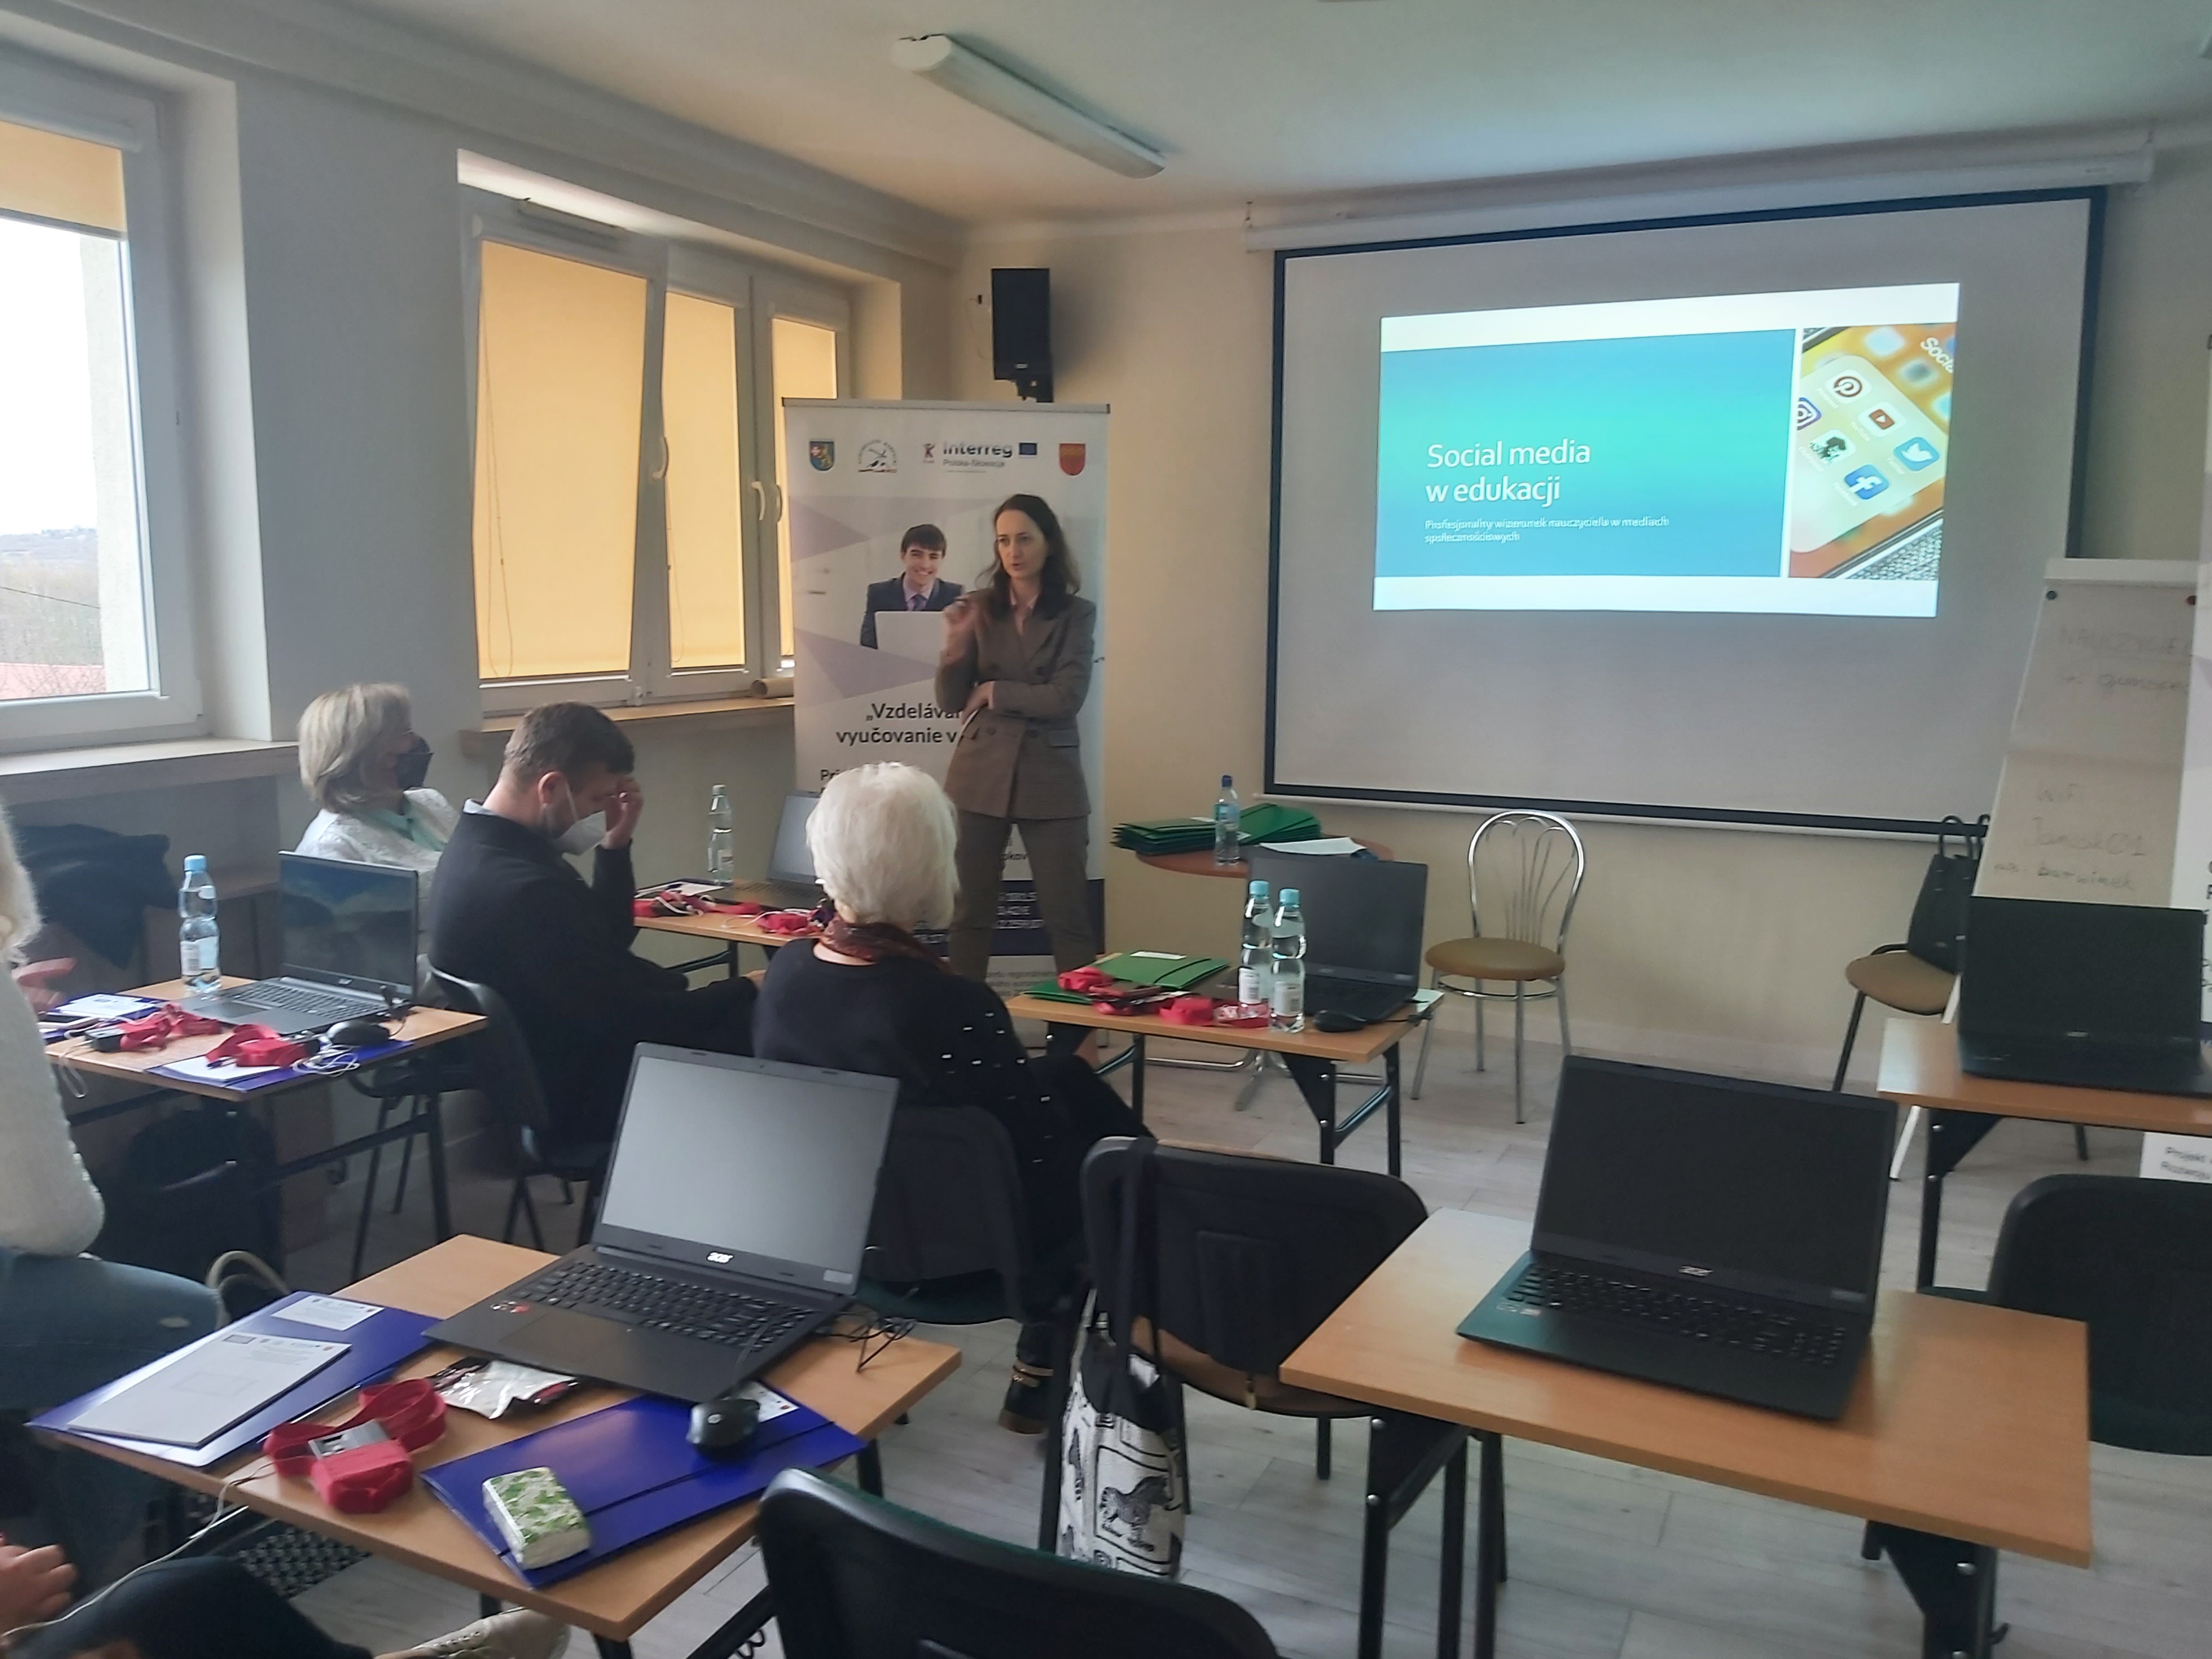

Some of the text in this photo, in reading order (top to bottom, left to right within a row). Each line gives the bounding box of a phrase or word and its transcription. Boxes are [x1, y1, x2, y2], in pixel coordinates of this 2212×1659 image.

[1427, 438, 1591, 467] Social media
[1425, 475, 1561, 508] w edukacji
[1425, 518, 1494, 532] Profesjonalny
[1494, 517, 1547, 528] wizerunek
[1548, 516, 1609, 531] nauczyciela
[1622, 515, 1669, 527] mediach
[836, 727, 957, 747] vyučovanie v
